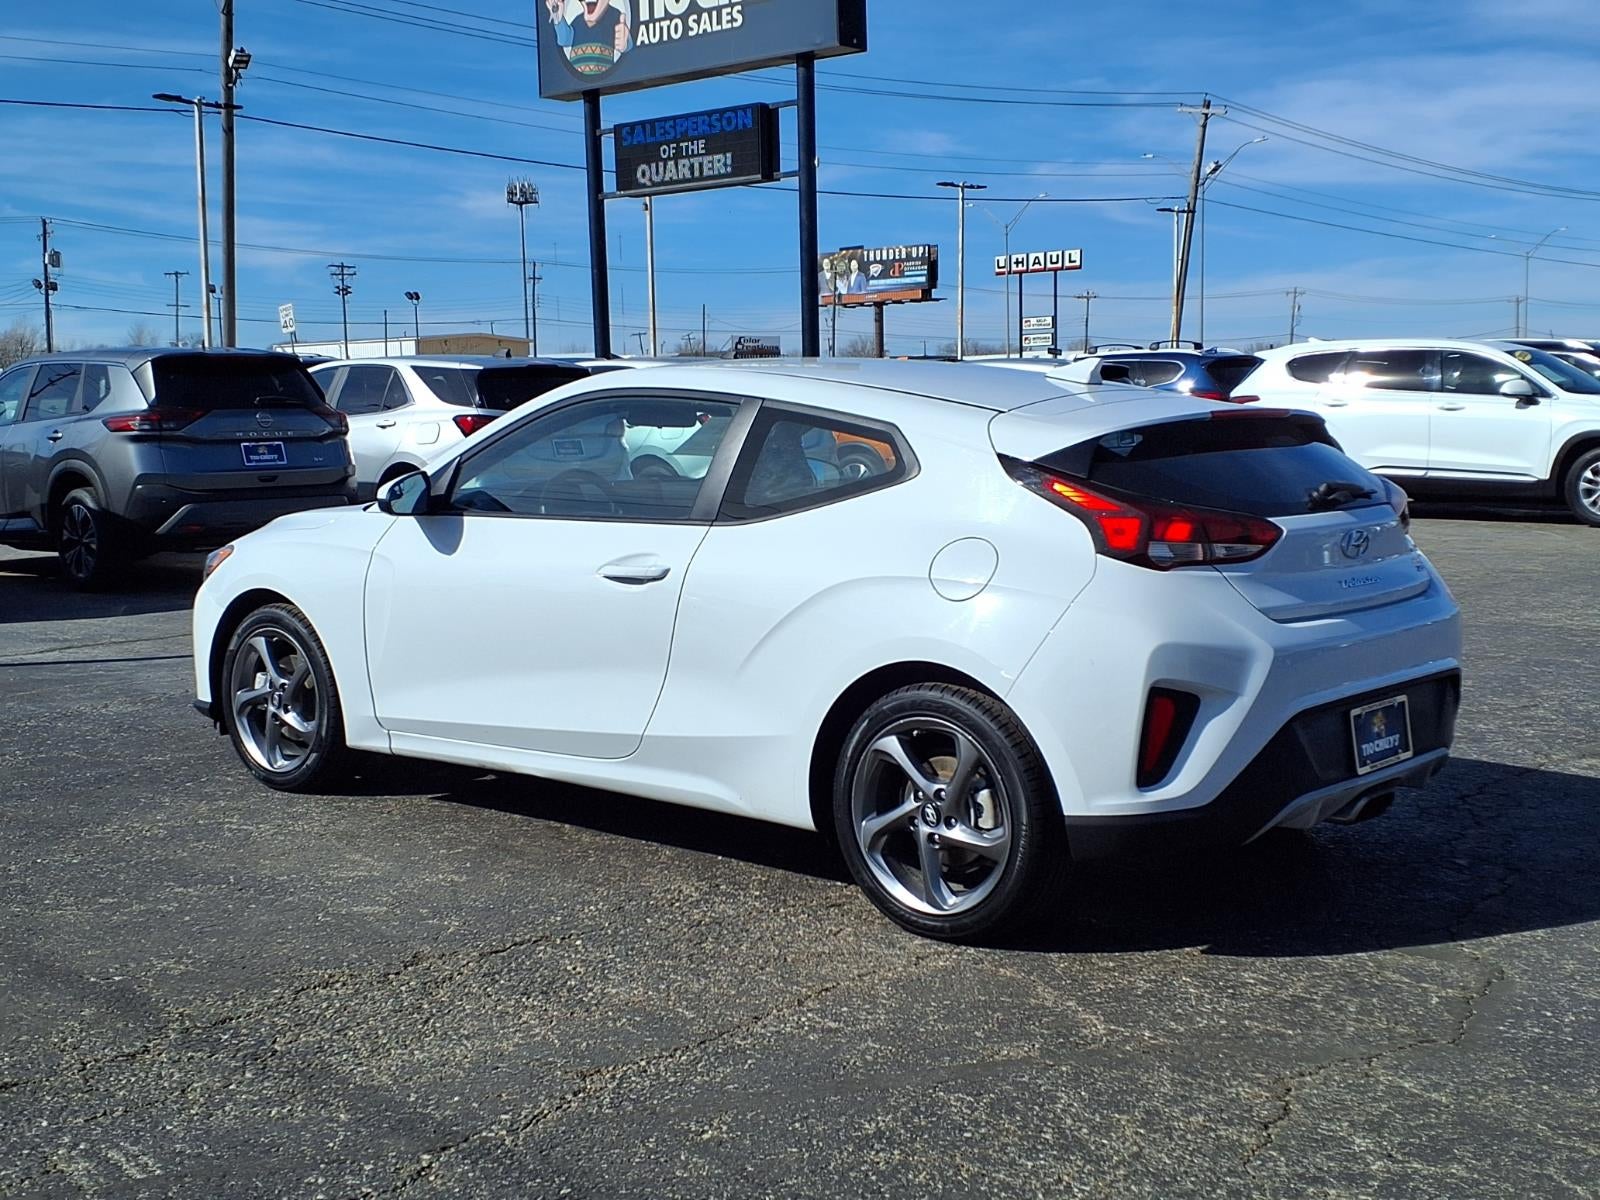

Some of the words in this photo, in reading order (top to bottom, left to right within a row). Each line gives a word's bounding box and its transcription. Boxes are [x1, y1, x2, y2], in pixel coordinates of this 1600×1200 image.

[636, 17, 684, 47] AUTO
[688, 4, 744, 37] SALES
[621, 107, 754, 147] SALESPERSON
[659, 144, 677, 159] OF
[680, 139, 706, 156] THE
[636, 152, 733, 186] QUARTER!
[864, 246, 907, 262] THUNDER
[911, 245, 929, 258] UP!
[282, 317, 294, 330] 40
